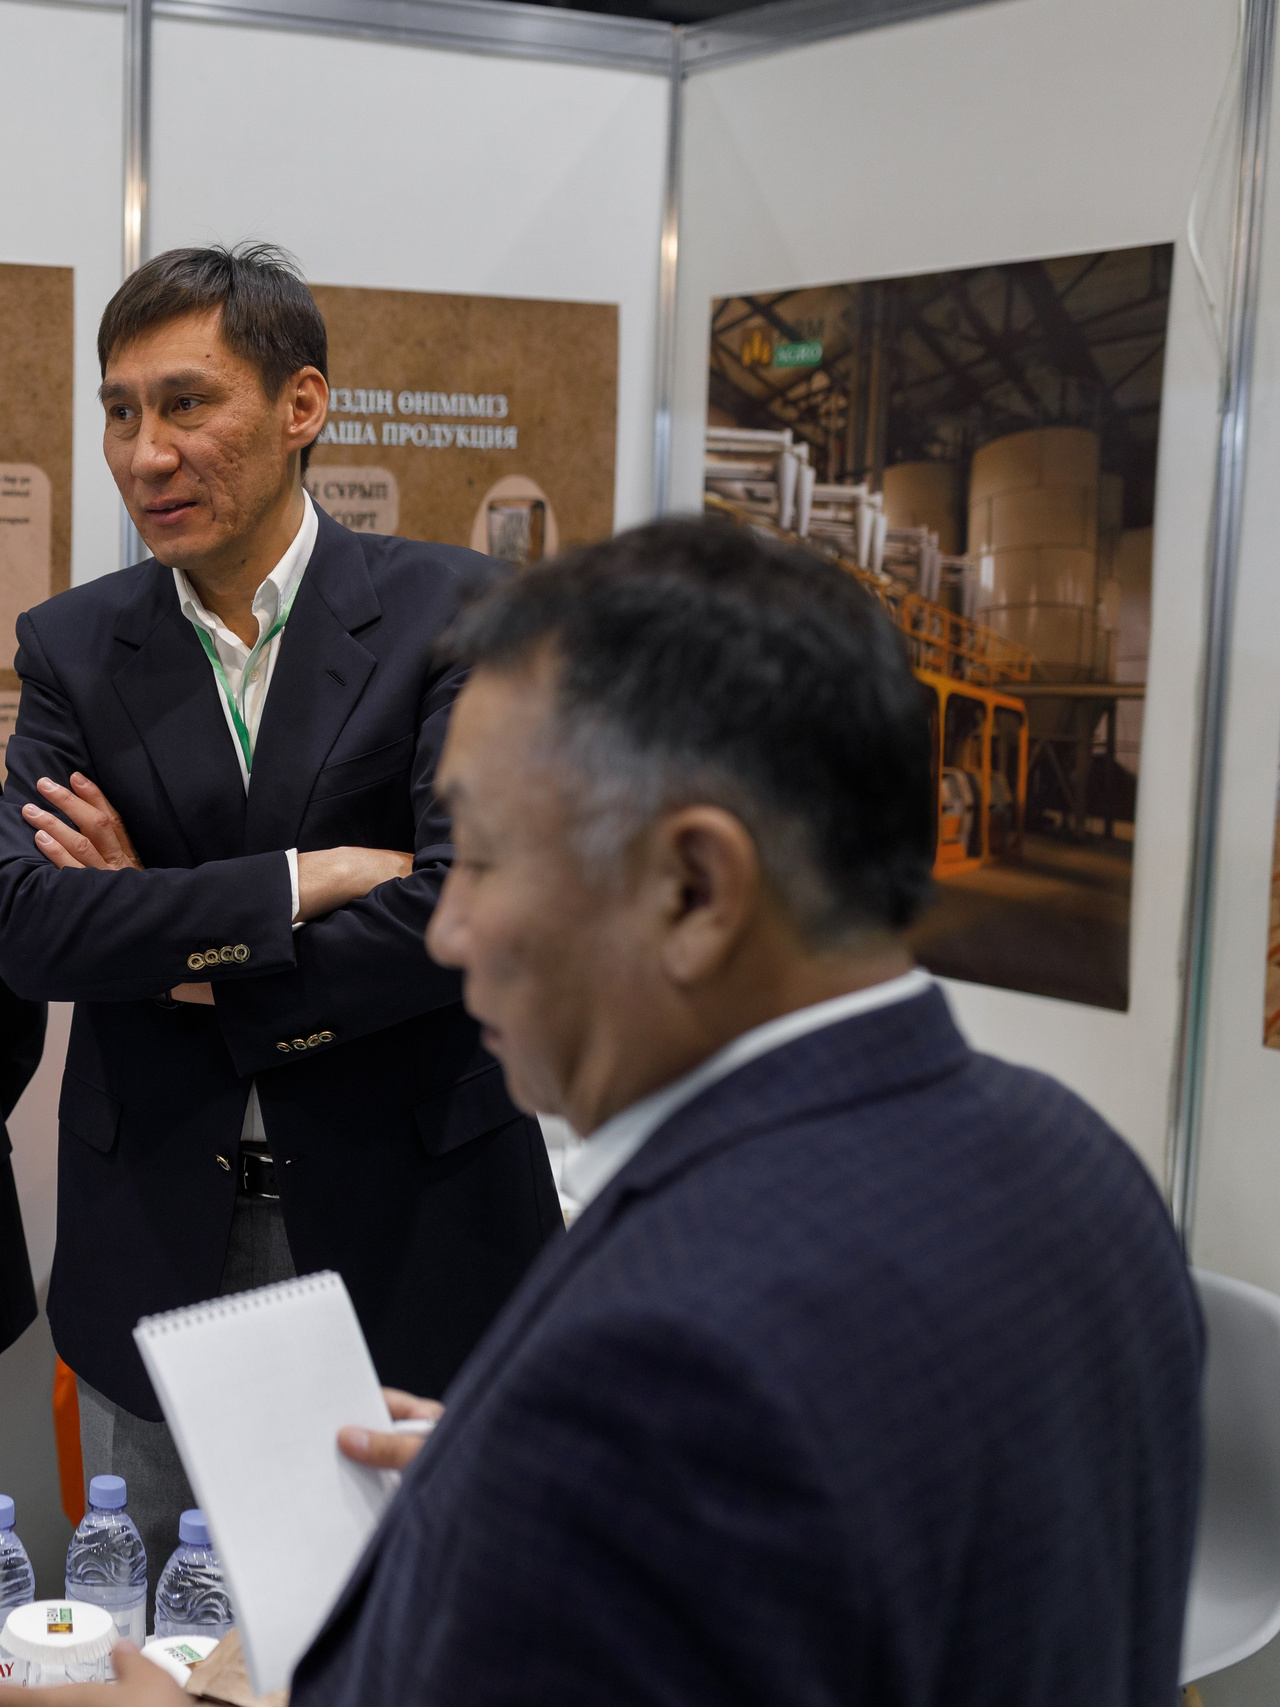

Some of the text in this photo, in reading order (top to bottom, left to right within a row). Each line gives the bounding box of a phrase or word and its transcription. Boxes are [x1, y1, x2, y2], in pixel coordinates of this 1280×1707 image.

[328, 388, 509, 419] ІЗДІҢ ӨНІМІМІЗ
[318, 421, 518, 451] АША ПРОДУКЦИЯ
